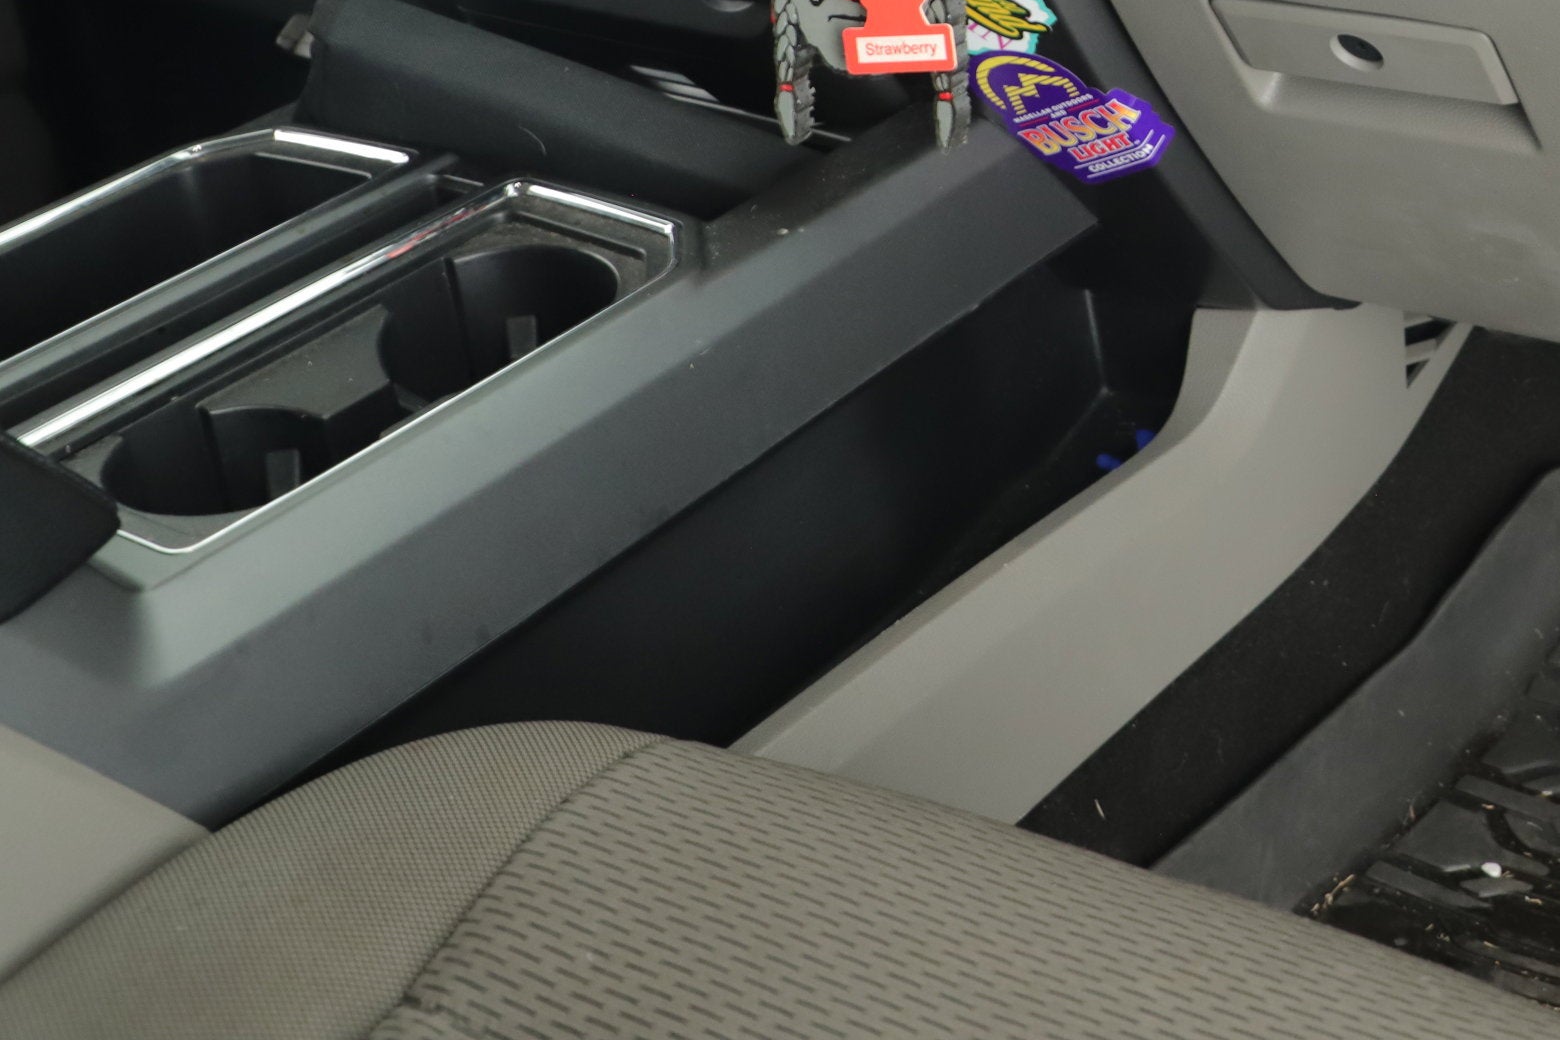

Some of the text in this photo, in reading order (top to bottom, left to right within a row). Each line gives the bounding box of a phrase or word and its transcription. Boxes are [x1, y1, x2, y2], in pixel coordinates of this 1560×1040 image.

[864, 42, 938, 58] Strawberry
[1013, 93, 1094, 124] MAGELLAN OUTDOORS
[1050, 109, 1068, 120] AND
[1017, 98, 1142, 156] BUSCH
[1067, 131, 1134, 162] LIGHT
[1087, 143, 1155, 173] COLLECTION
